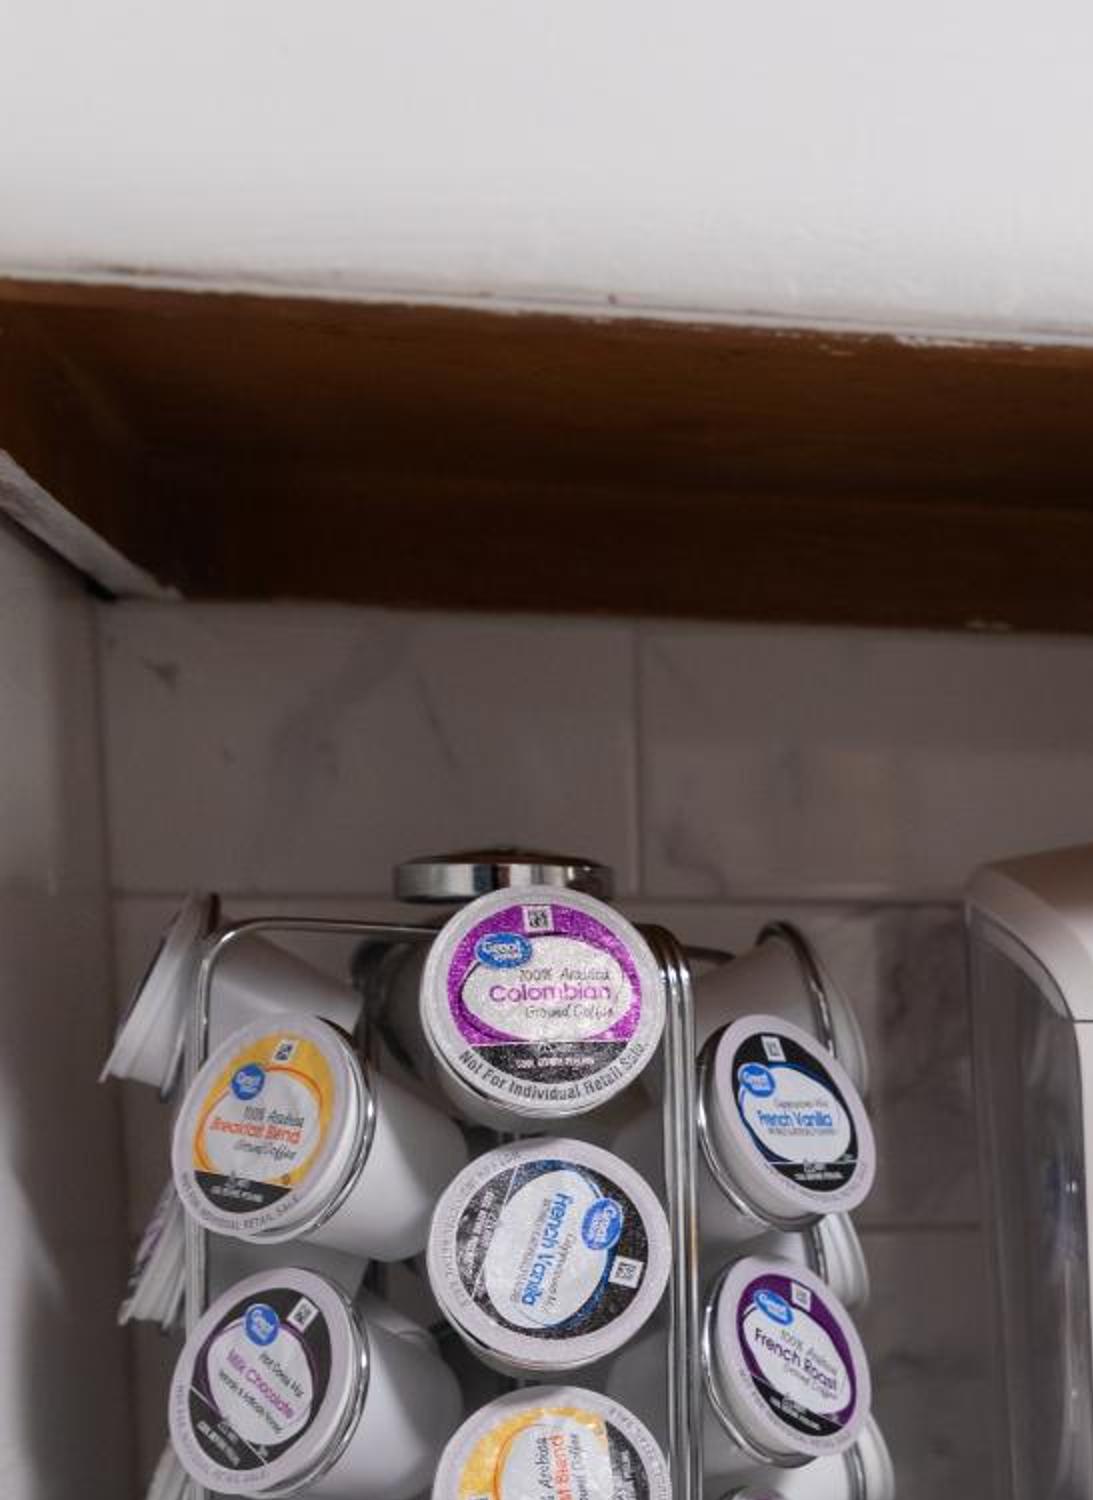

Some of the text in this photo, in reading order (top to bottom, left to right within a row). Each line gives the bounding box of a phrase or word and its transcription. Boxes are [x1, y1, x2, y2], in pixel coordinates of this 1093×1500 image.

[488, 983, 613, 1004] Colombian
[519, 969, 551, 983] 100%
[525, 1004, 571, 1018] Ground
[459, 1050, 482, 1071] Not
[483, 1065, 506, 1088] For
[508, 1083, 581, 1101] Individual
[584, 1066, 623, 1096] Retail
[209, 1117, 302, 1144] Breakfast Blend
[757, 1109, 834, 1128] French Vanilla
[541, 1193, 573, 1251] French
[520, 1254, 555, 1307] Vanilla
[754, 1327, 838, 1390] French Roast
[245, 1367, 296, 1420] Chocolate
[550, 1434, 571, 1487] Blend
